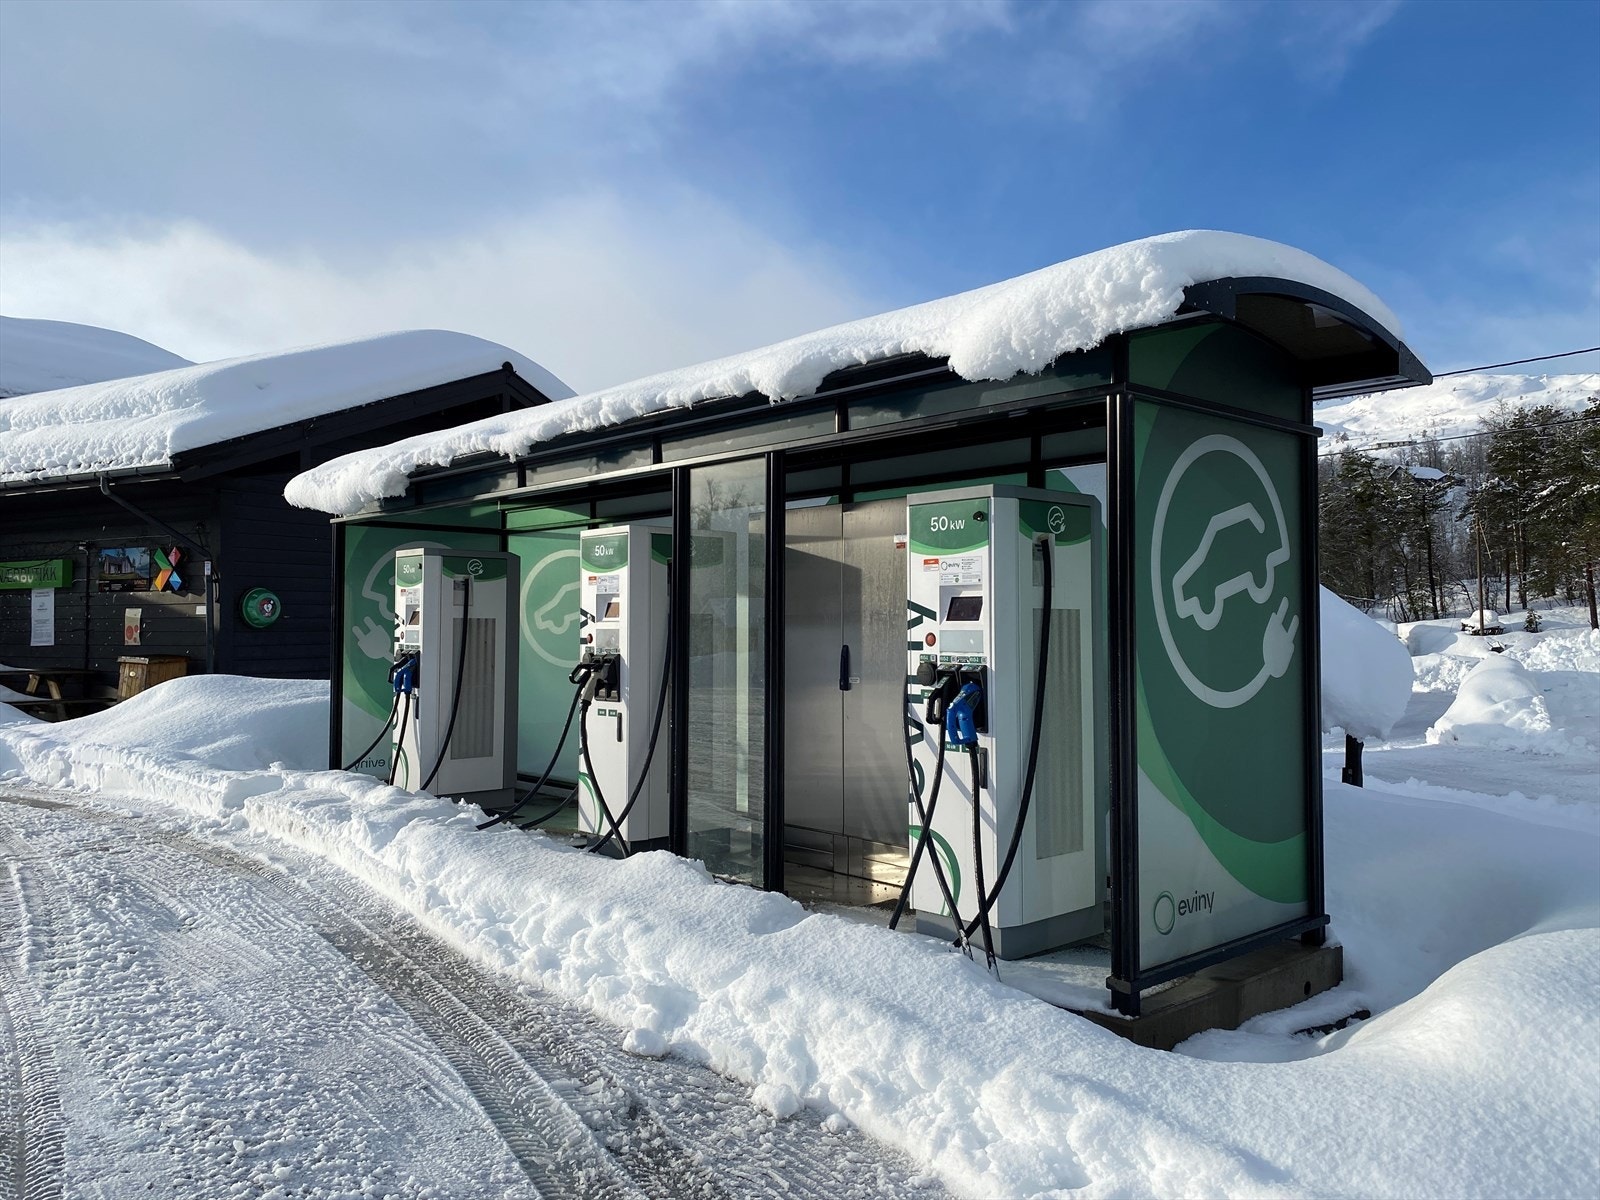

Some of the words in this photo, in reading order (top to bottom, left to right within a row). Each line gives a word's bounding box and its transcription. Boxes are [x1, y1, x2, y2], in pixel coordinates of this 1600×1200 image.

[930, 516, 948, 531] 50
[950, 519, 965, 530] kW
[594, 545, 605, 557] 50
[1178, 890, 1215, 915] eviny
